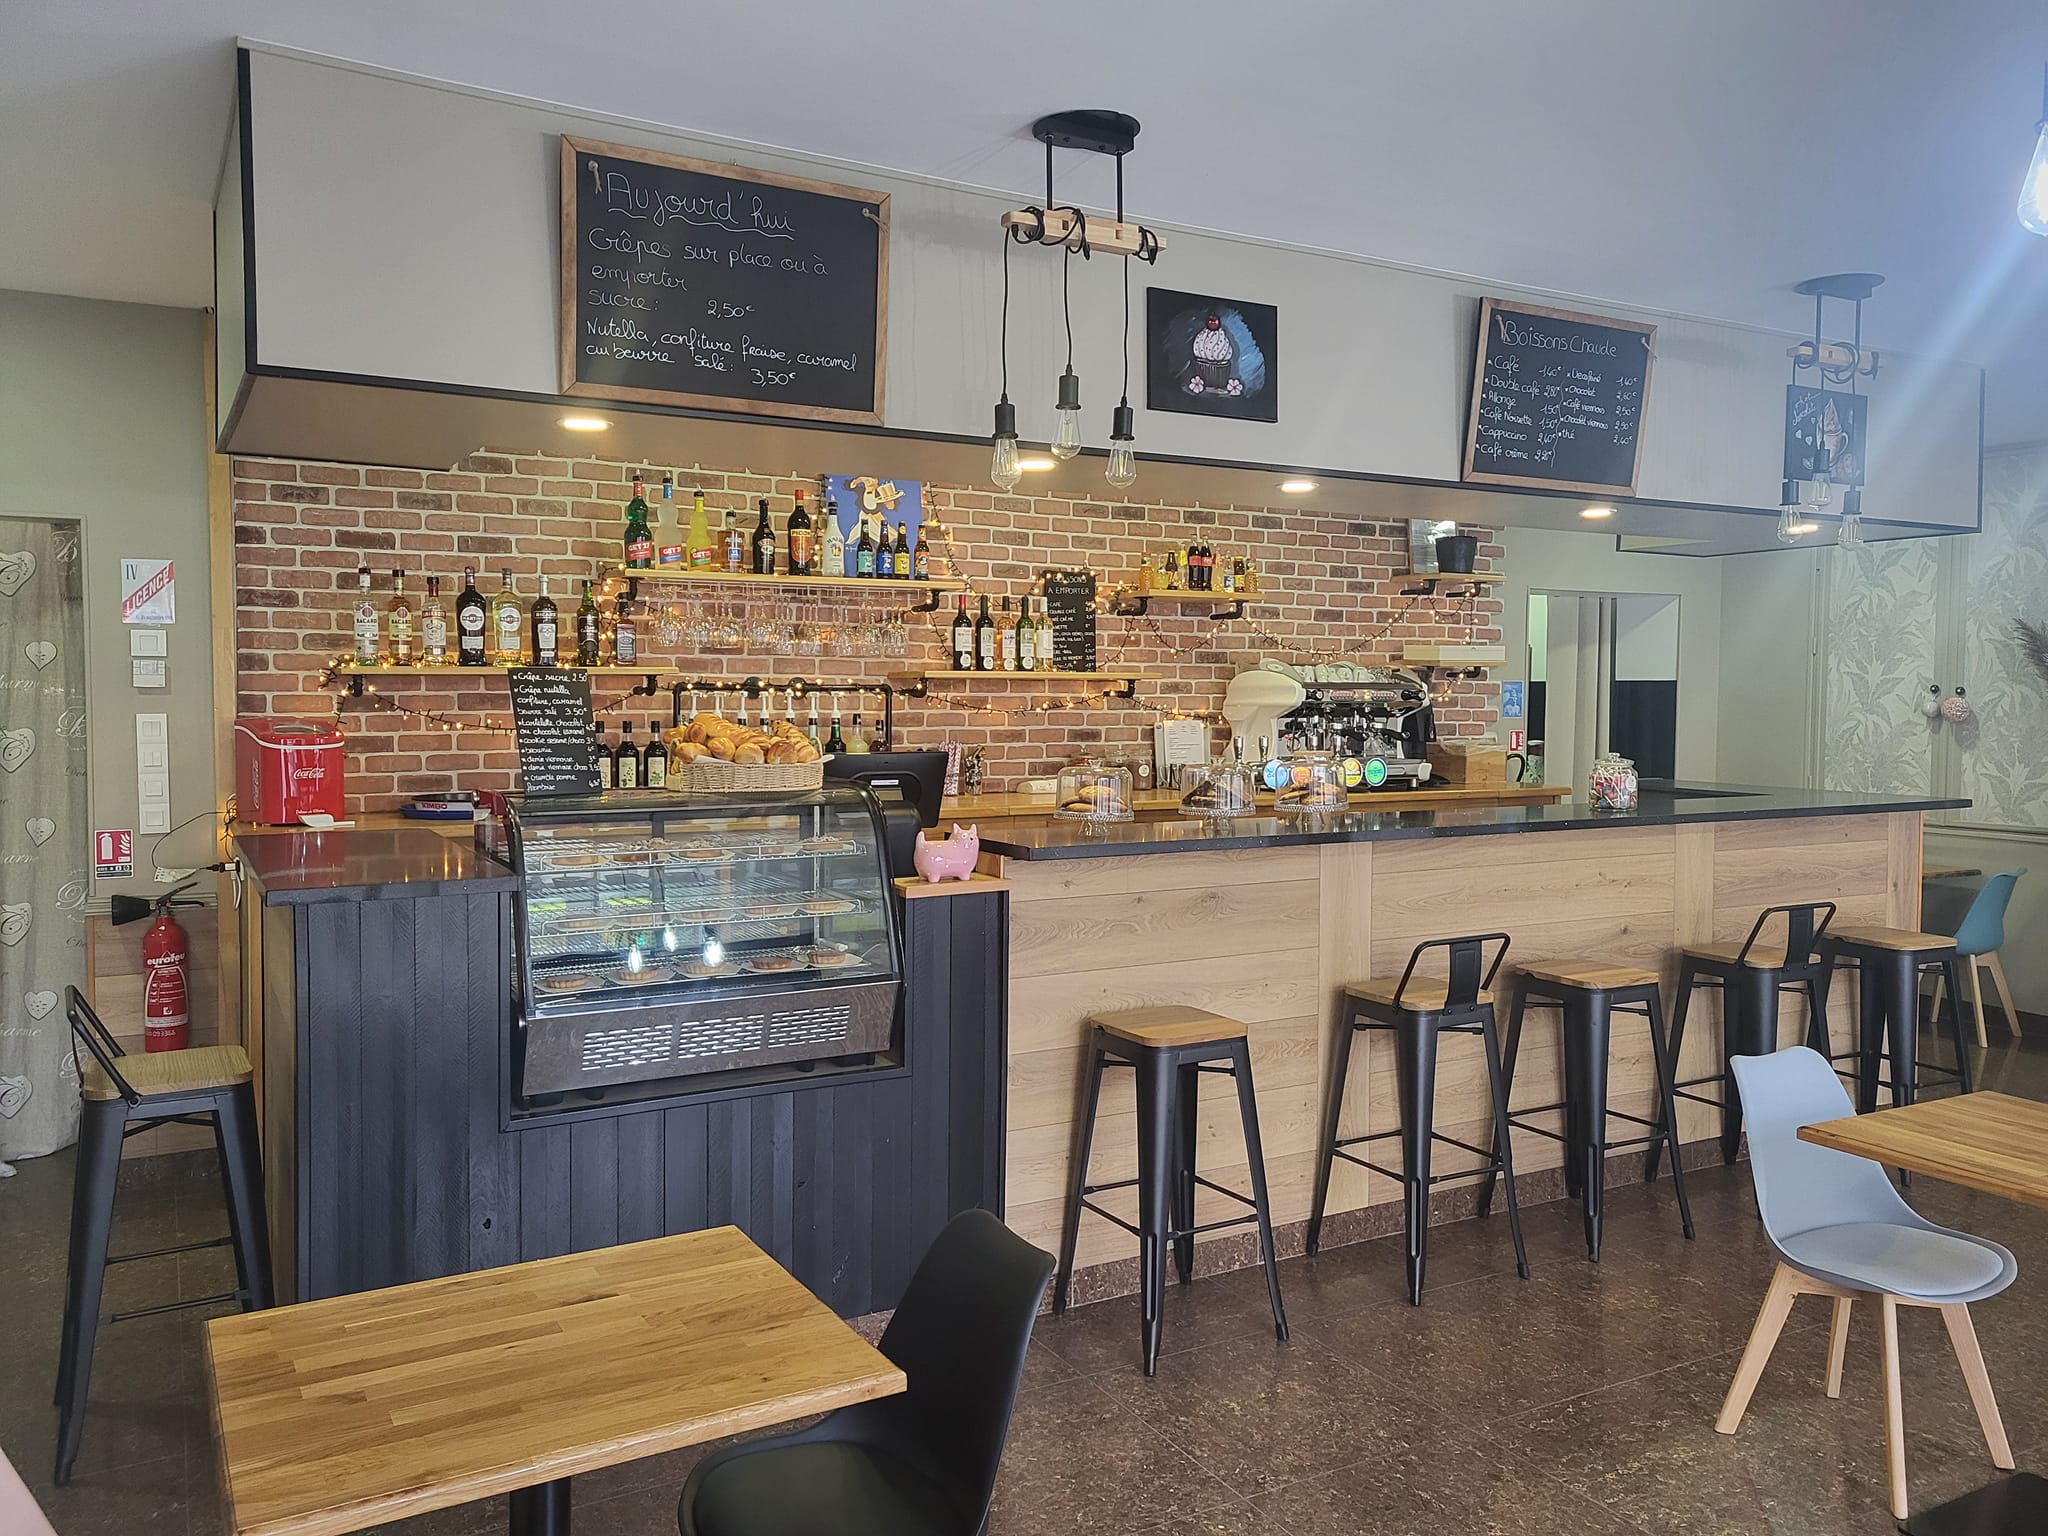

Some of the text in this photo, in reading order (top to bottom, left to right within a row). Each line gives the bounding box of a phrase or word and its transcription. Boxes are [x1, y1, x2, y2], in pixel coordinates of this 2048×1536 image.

[607, 172, 796, 232] Aujourd'hui
[588, 227, 829, 275] Crêpes sur place ou à
[591, 265, 687, 291] emporter
[660, 327, 735, 358] confiture
[796, 352, 859, 373] caramel
[1503, 320, 1618, 358] Boissons Chaude
[613, 342, 676, 364] beurre
[1494, 354, 1520, 377] Café
[1491, 374, 1520, 391] Double
[1521, 380, 1541, 400] café
[1484, 406, 1503, 424] Café
[1566, 398, 1581, 414] Café
[1480, 441, 1503, 462] Café
[628, 544, 642, 552] GET
[126, 564, 138, 580] IV
[122, 566, 170, 618] LICENCE
[421, 802, 448, 810] KIMBO
[146, 953, 186, 967] eurofeu
